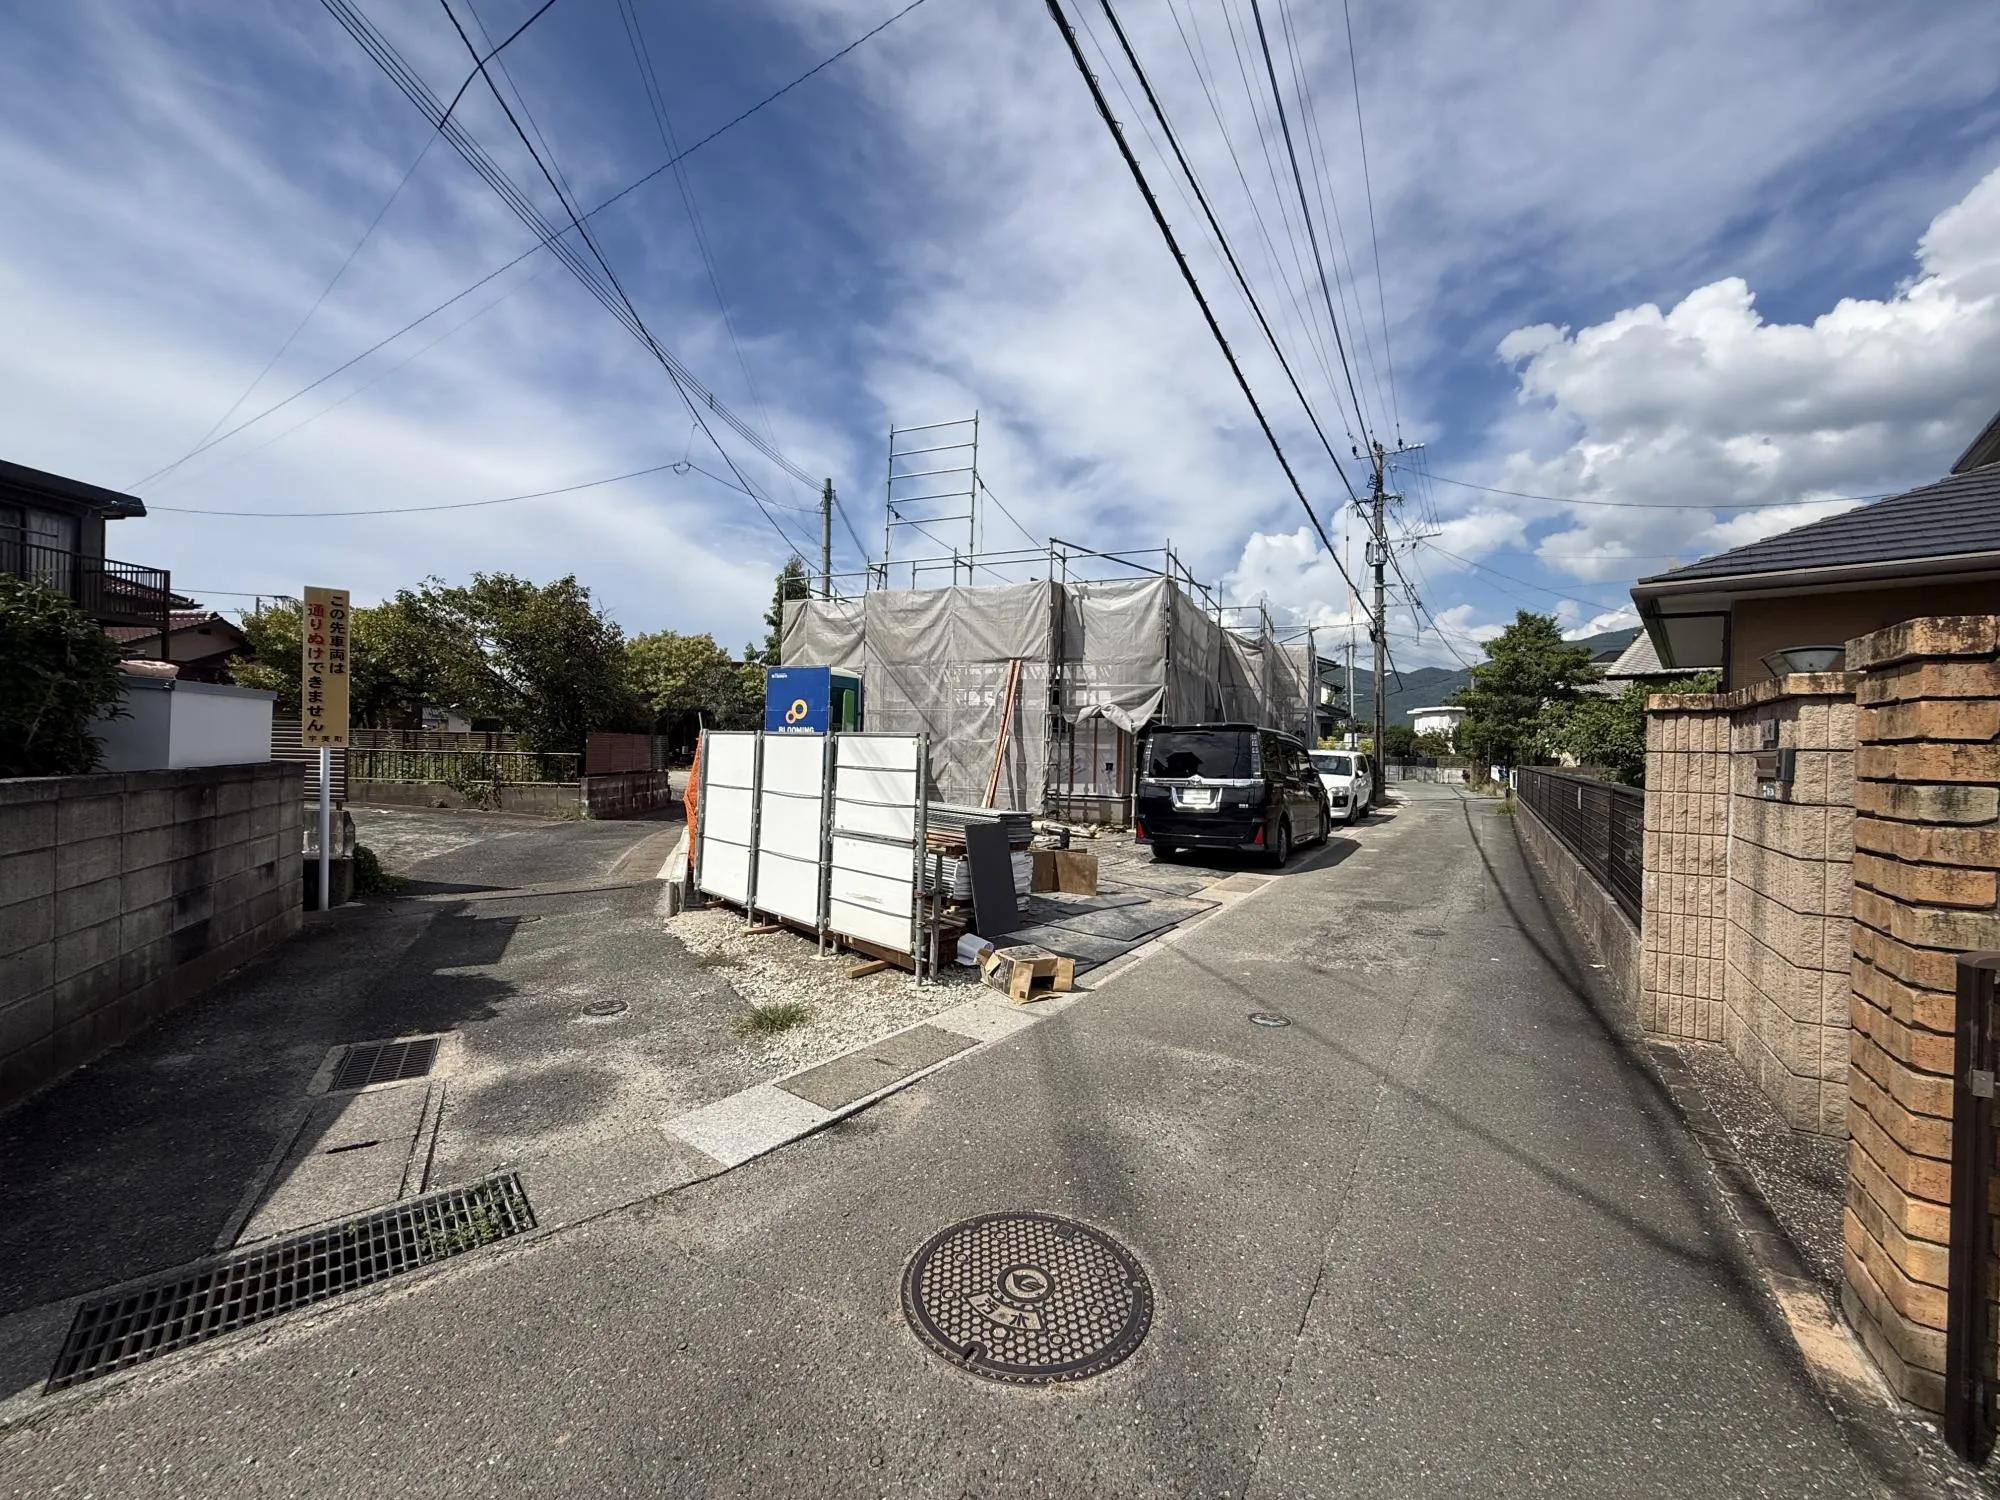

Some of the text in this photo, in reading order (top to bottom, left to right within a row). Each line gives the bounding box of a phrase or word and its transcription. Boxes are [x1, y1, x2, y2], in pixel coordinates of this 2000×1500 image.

[307, 603, 325, 732] 通りぬけできません
[330, 595, 346, 674] この先車両は
[976, 1297, 1030, 1329] 汚水
